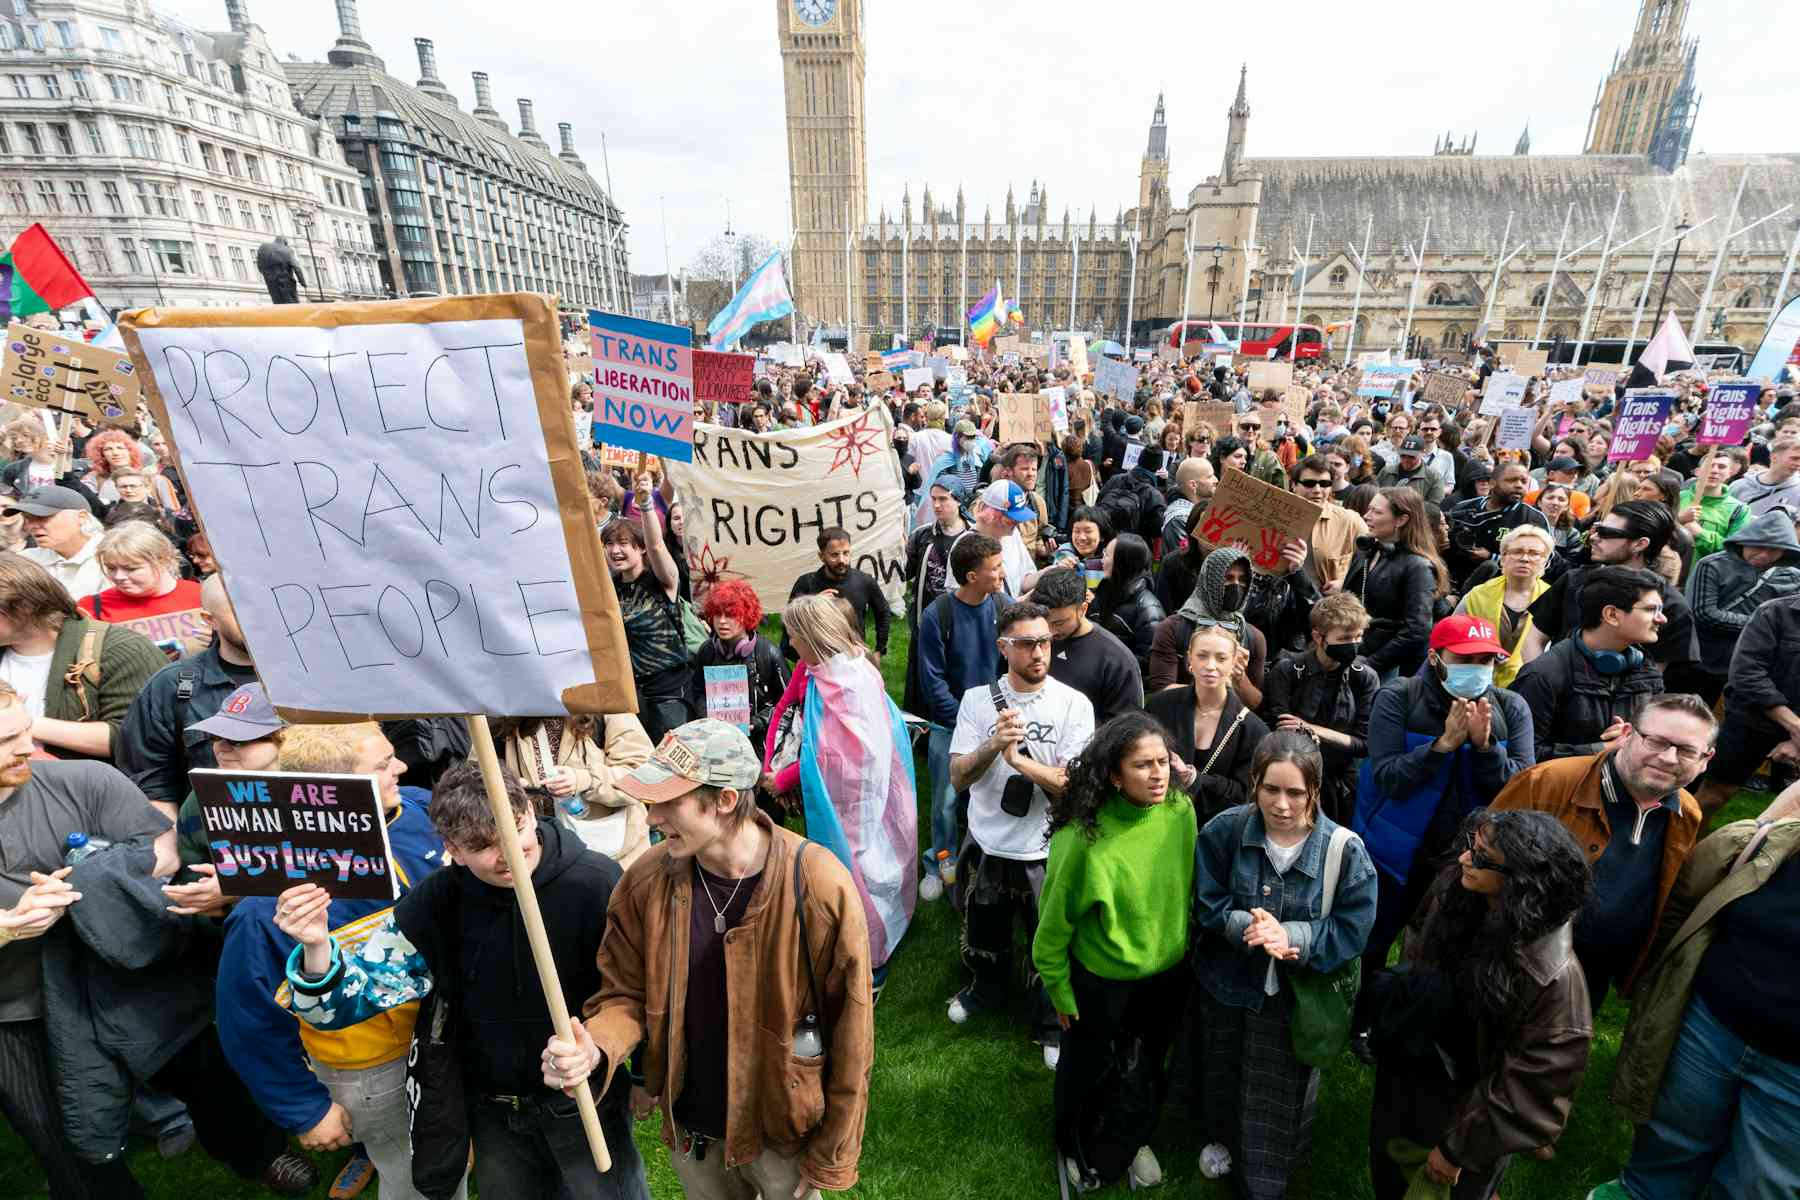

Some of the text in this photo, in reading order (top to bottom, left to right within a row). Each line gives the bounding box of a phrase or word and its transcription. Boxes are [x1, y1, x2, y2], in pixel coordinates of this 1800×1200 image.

[596, 333, 678, 372] TRANS
[35, 377, 51, 402] eco
[162, 342, 523, 444] PROTECT
[595, 367, 690, 402] LIBERATION
[1708, 385, 1747, 403] Trans
[605, 397, 684, 434] NOW
[1622, 398, 1660, 416] Trans
[1706, 403, 1751, 423] Rights
[1617, 417, 1662, 438] Rights
[1703, 421, 1729, 438] Now
[693, 428, 799, 470] RANS
[1611, 437, 1640, 454] Now
[192, 461, 539, 561] TRANS
[711, 490, 878, 546] RIGHTS
[856, 550, 907, 585] OW
[271, 579, 578, 673] PEOPLE
[227, 694, 252, 714] B
[225, 780, 338, 807] WE ARE
[203, 806, 373, 833] HUMAN BEINGS
